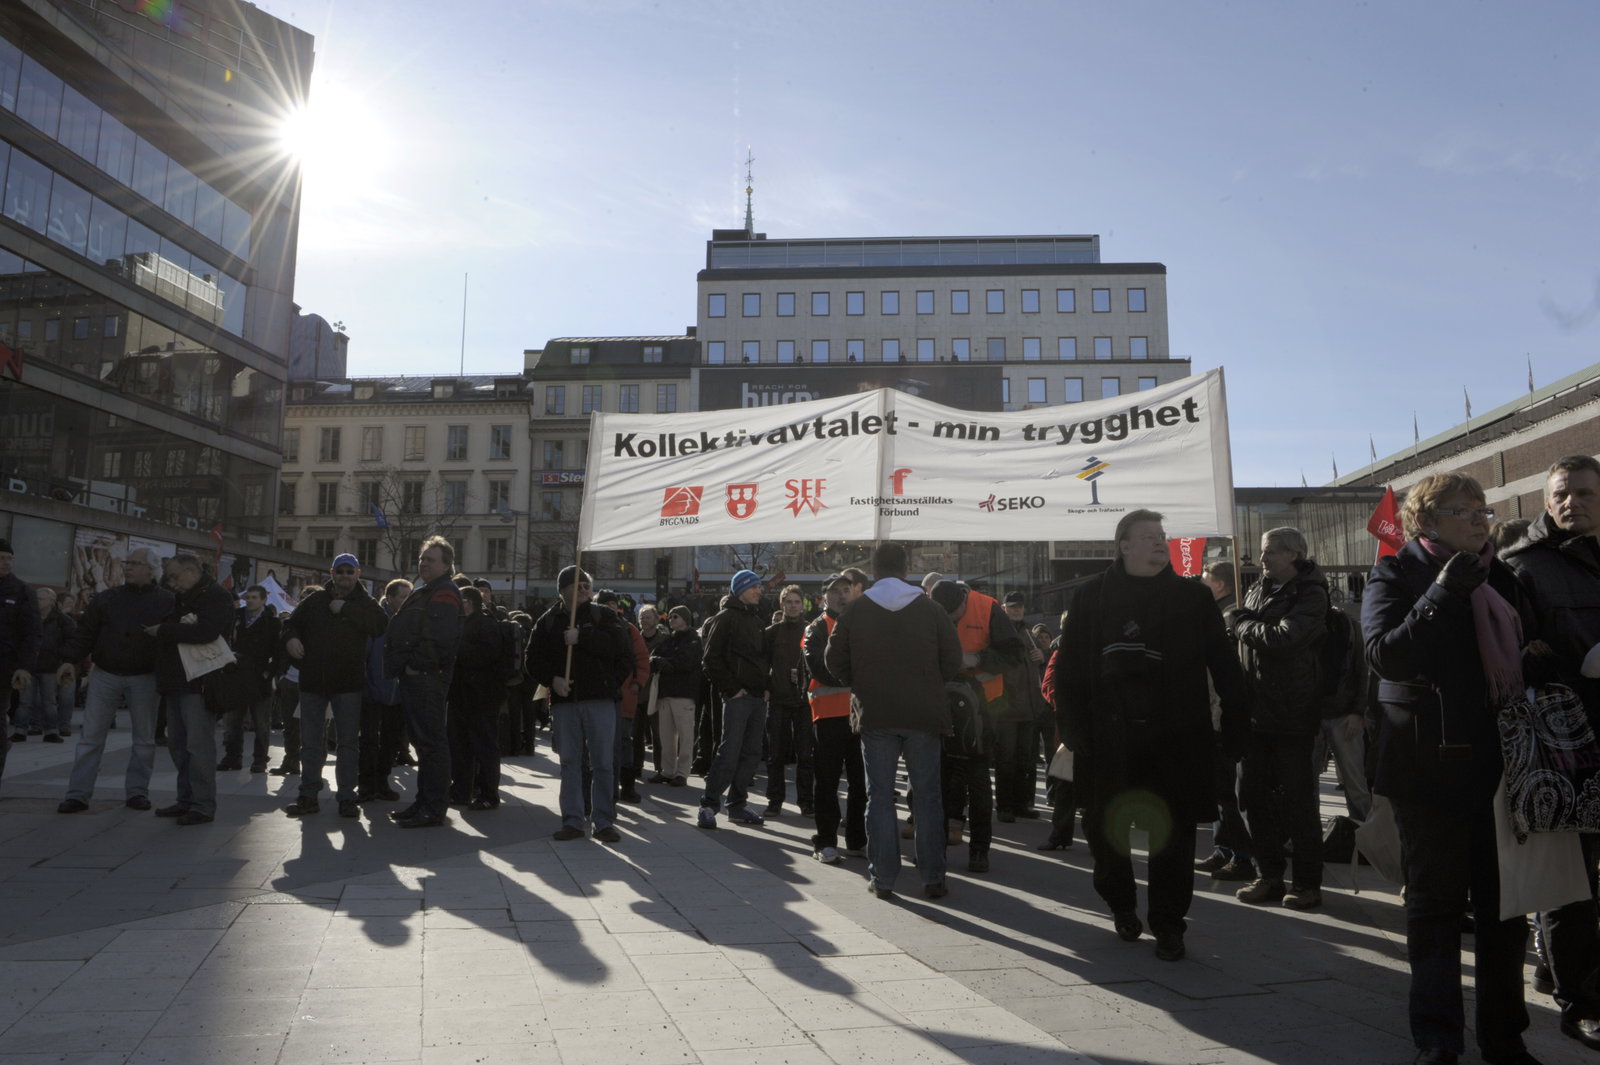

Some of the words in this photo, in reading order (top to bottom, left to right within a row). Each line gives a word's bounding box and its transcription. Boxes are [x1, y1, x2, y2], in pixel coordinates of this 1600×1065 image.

[614, 410, 898, 457] Kollektivavtalet
[932, 421, 1000, 441] min
[1022, 396, 1200, 445] trygghet
[784, 478, 827, 499] SEF
[850, 496, 953, 506] Fastighetsanställdas
[997, 496, 1046, 511] SEKO
[659, 517, 699, 526] BYGGNADS
